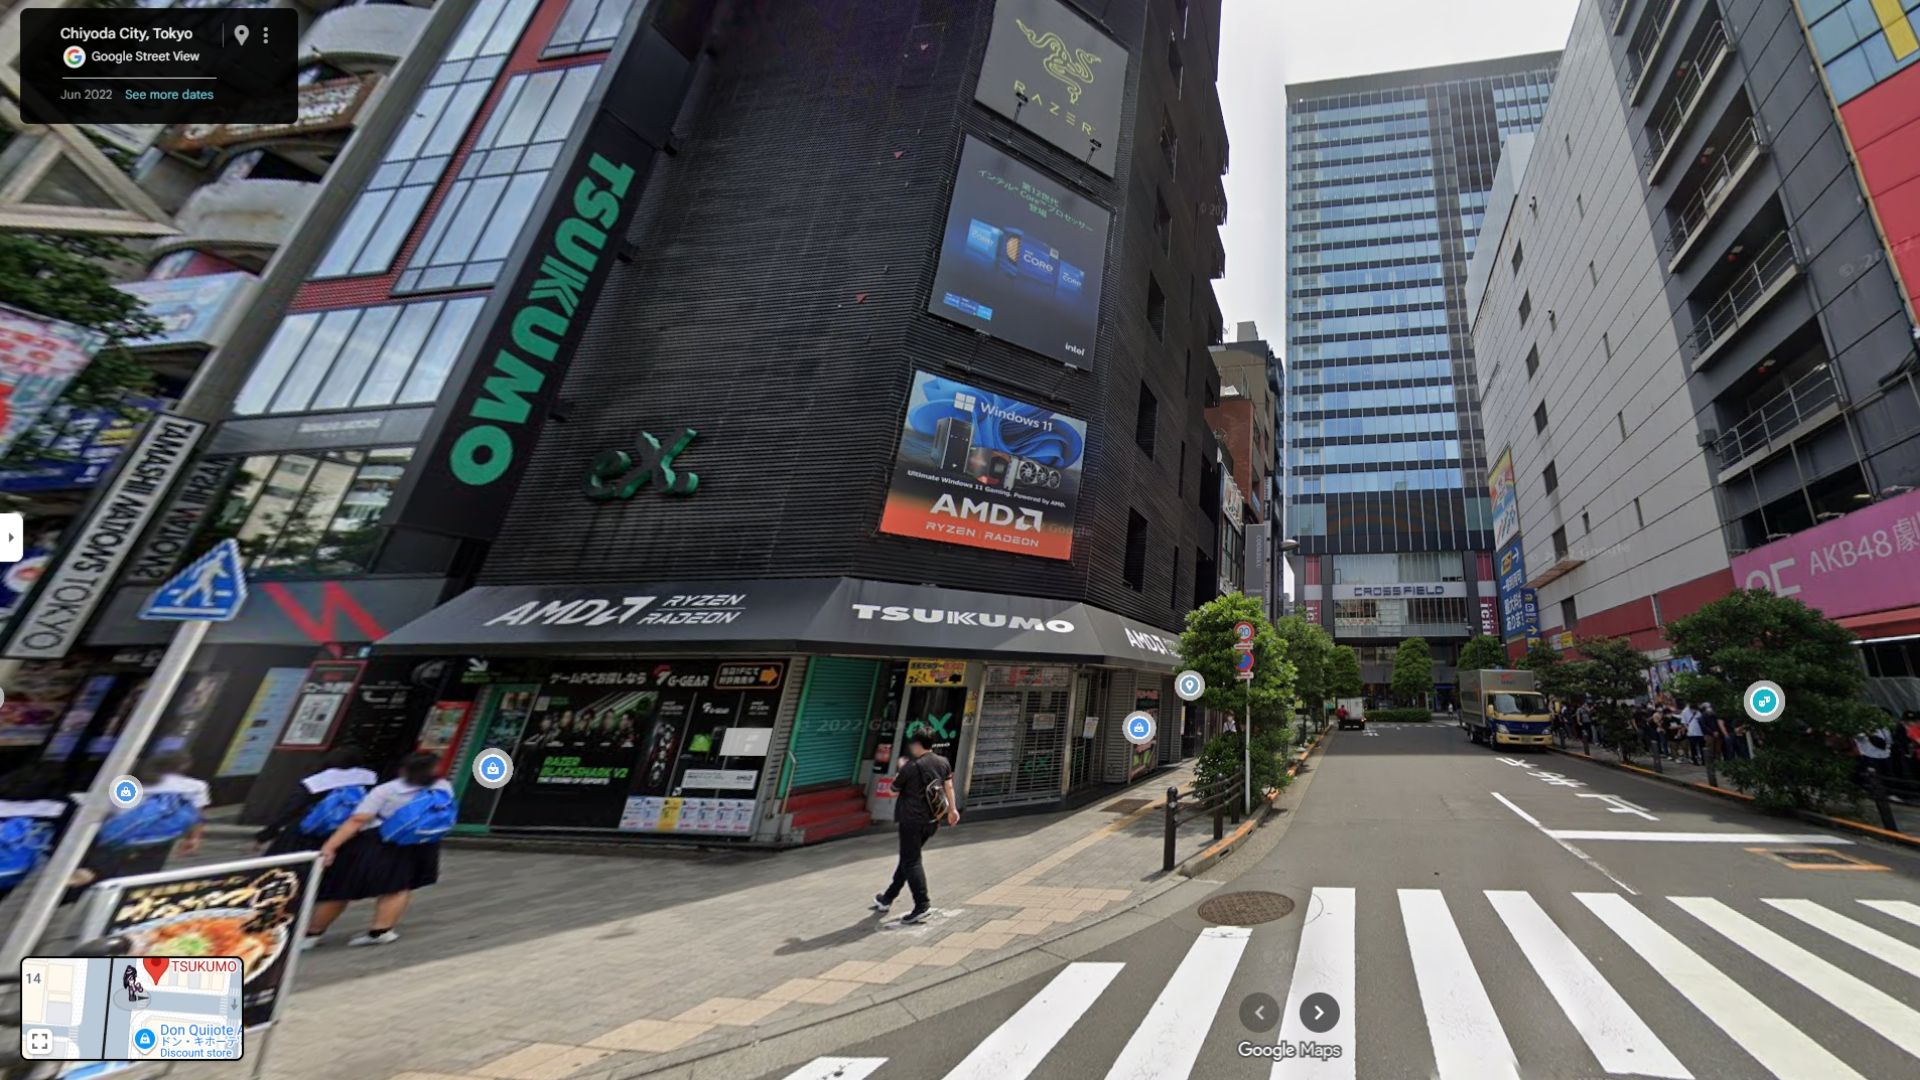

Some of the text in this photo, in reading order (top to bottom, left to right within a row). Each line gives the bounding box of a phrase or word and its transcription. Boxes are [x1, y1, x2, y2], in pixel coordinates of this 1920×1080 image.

[450, 152, 635, 486] TSUKUMO
[1065, 342, 1086, 357] intel
[980, 402, 1053, 432] Windows 11
[122, 421, 196, 494] TAMASHII
[907, 469, 940, 482] Ultimate
[941, 476, 973, 489] Windows
[1042, 498, 1050, 506] by
[930, 493, 1015, 527] AMD
[73, 493, 144, 573] NATIONS
[925, 520, 1041, 548] RYZEN RADEON
[22, 578, 99, 650] TOKYO
[482, 599, 611, 627] AMD
[662, 594, 746, 607] RYZEN
[636, 611, 743, 625] RADEON
[851, 603, 1076, 634] TSUKUMO
[1124, 627, 1158, 652] AMD
[667, 675, 710, 687] G-GEAR
[1495, 756, 1661, 821] 止まれ
